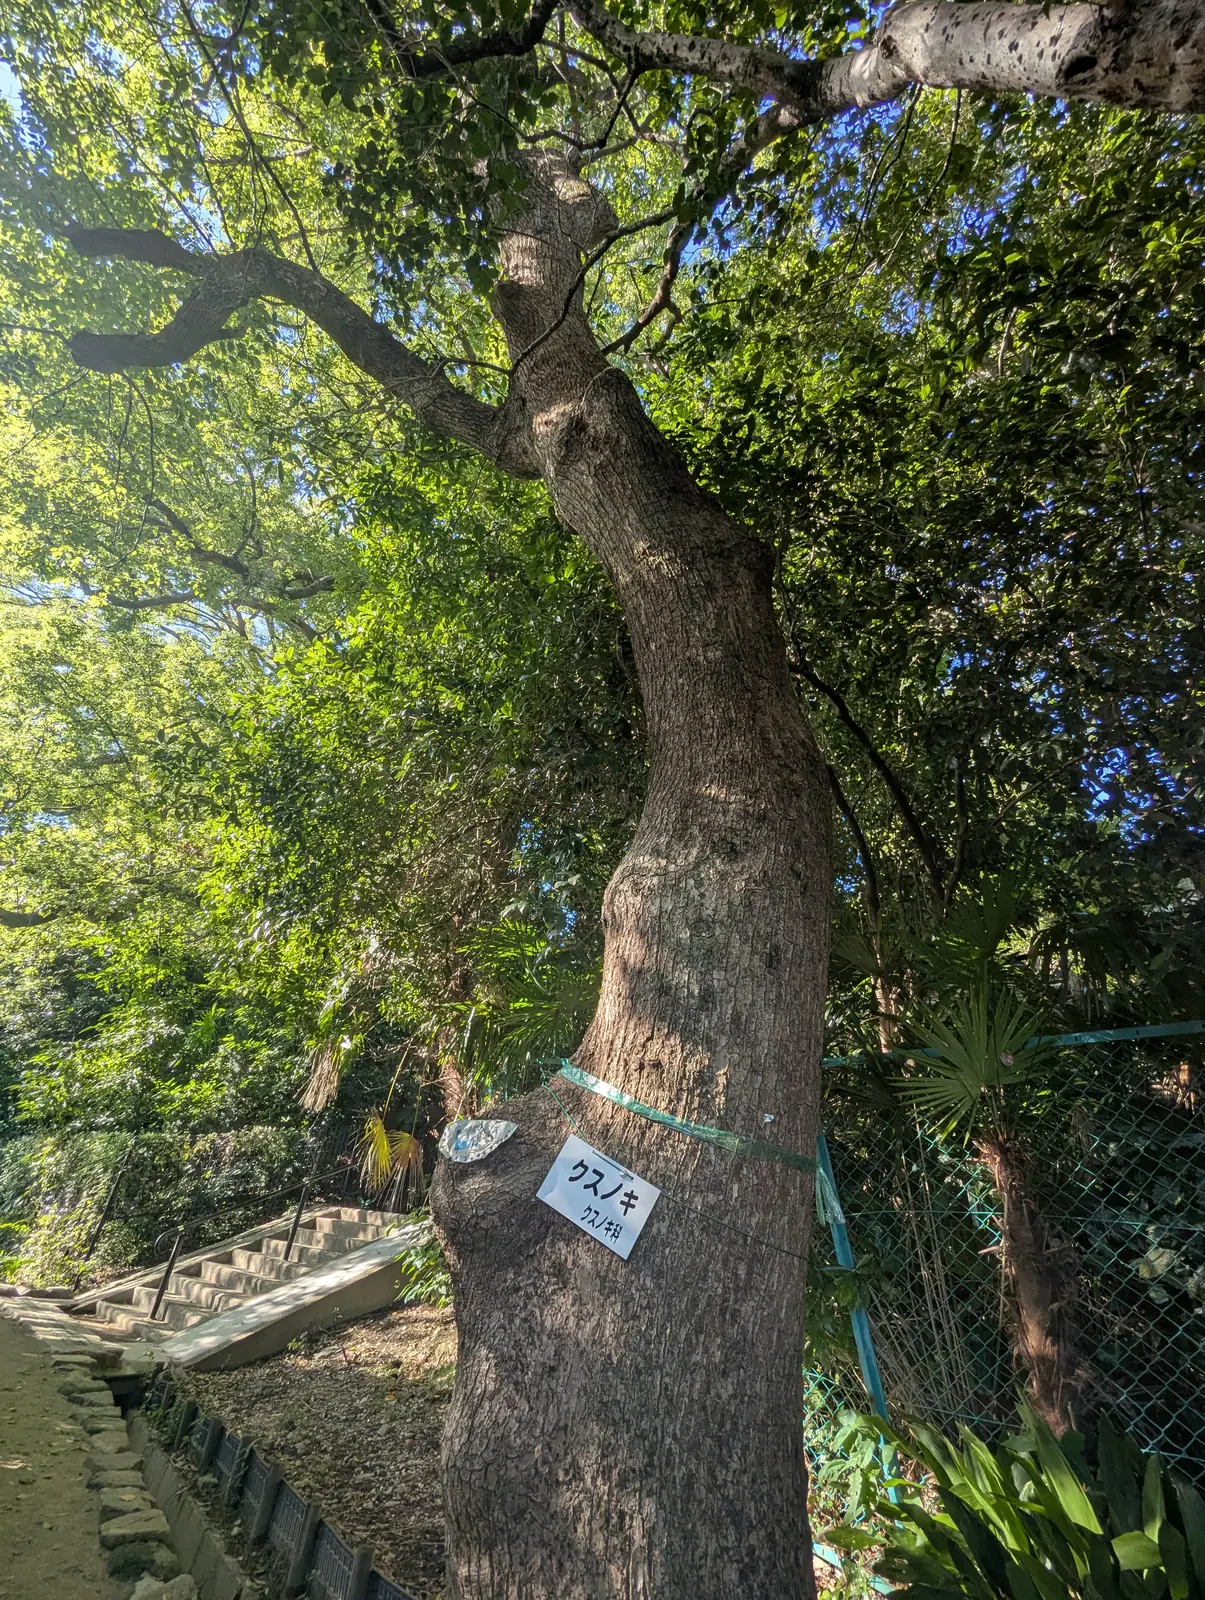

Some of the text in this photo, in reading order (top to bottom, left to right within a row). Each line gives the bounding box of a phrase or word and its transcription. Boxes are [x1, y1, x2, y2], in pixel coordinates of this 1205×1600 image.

[568, 1159, 639, 1216] クスノキ
[580, 1205, 624, 1244] クスノキ科
